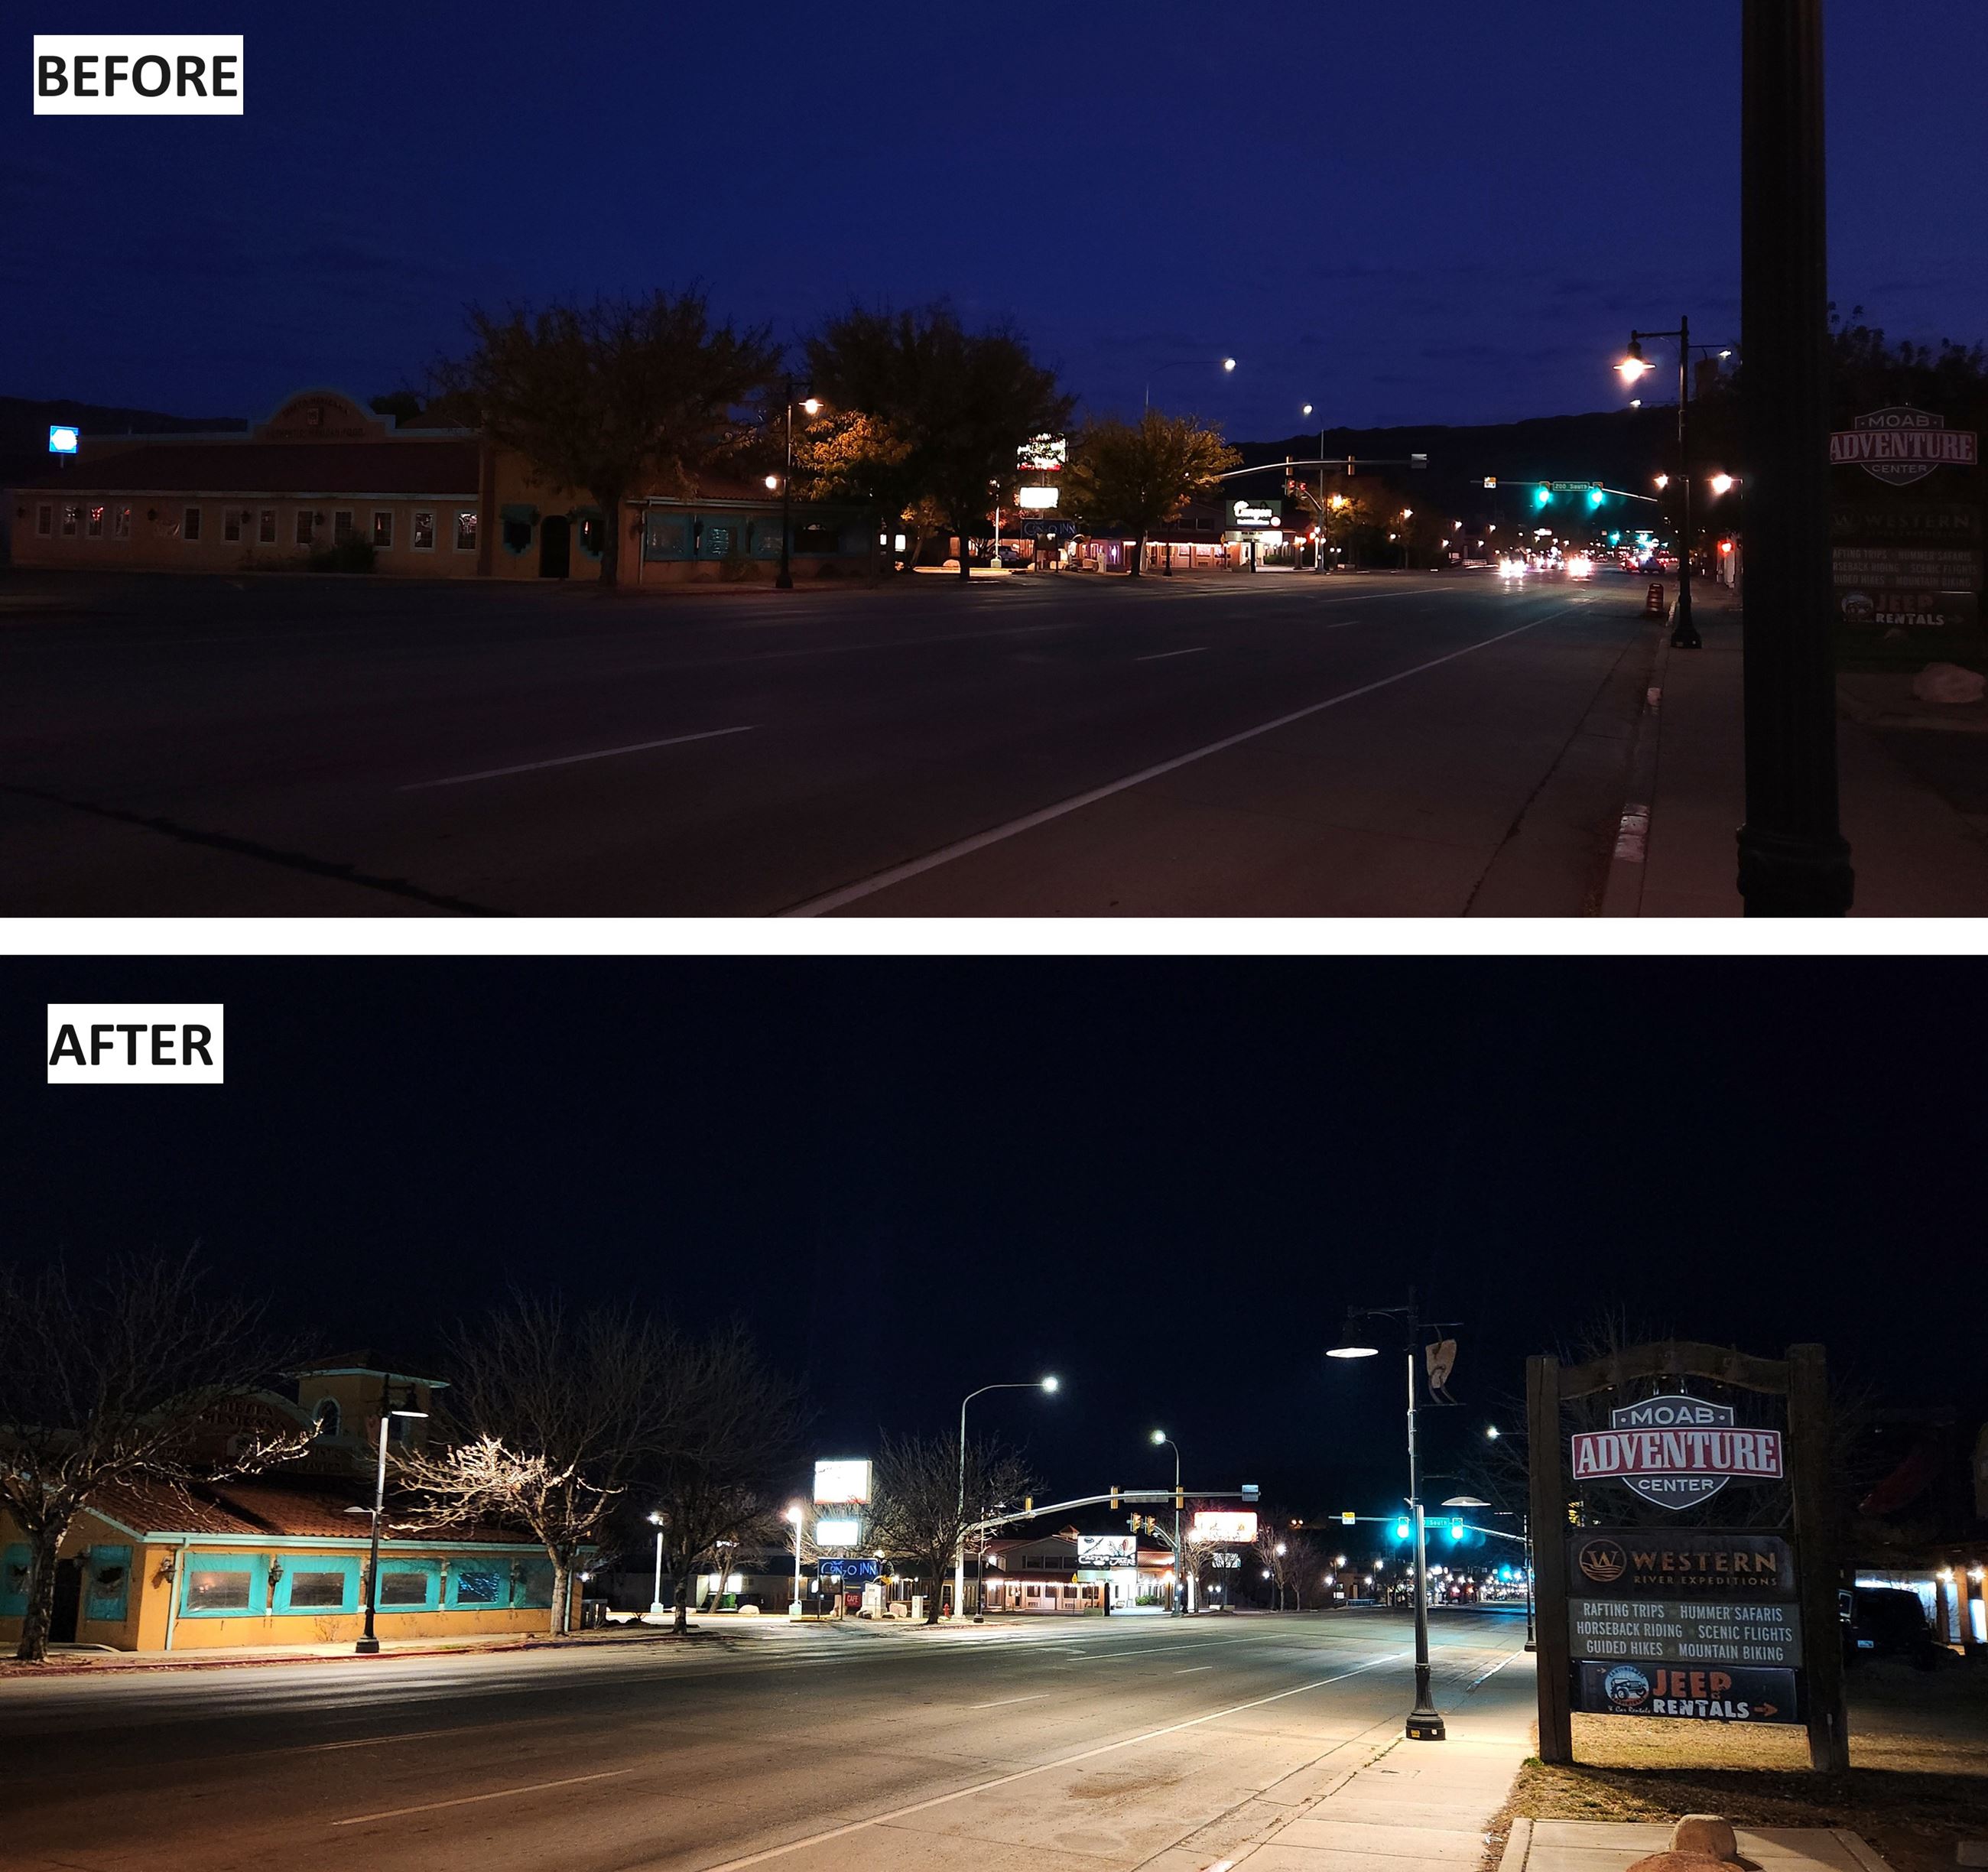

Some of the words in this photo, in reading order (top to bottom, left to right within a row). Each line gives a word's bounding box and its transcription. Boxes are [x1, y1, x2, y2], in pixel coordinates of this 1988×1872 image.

[1869, 414, 1929, 427] MOAB
[1830, 432, 1973, 461] ADVENTURE
[1872, 464, 1928, 473] CENTER
[1864, 514, 1970, 528] WESTERN
[1832, 549, 1861, 558] AFTING
[1864, 550, 1887, 559] TRIPS
[1938, 551, 1971, 561] SAFARIS
[1872, 563, 1900, 572] RIDING
[1910, 564, 1941, 574] SCENIC
[1944, 564, 1977, 574] FLIGHTS
[1861, 575, 1885, 585] HIKES
[1896, 576, 1939, 587] MOUNTAIN
[1942, 577, 1971, 587] BIKING
[1875, 594, 1934, 612] JEEP
[1875, 613, 1944, 626] RENTALS
[1631, 1406, 1714, 1425] MOAB
[1577, 1432, 1777, 1474] ADVENTURE
[1638, 1478, 1714, 1492] CENTER
[859, 1562, 877, 1575] INN
[1630, 1551, 1777, 1573] WESTERN
[1633, 1575, 1675, 1584] RIVER
[1682, 1576, 1778, 1586] EXPEDITIONS
[1584, 1602, 1629, 1617] RAFTING
[1632, 1604, 1665, 1618] TRIPS
[1680, 1605, 1730, 1620] HUMMER
[1734, 1607, 1782, 1622] SAFARIS
[1577, 1621, 1640, 1636] HORSEBACK
[1643, 1623, 1682, 1638] RIDING
[1698, 1625, 1740, 1640] SCENIC
[1744, 1627, 1792, 1642] FLIGHTS
[1587, 1640, 1626, 1654] GUIDED
[1630, 1642, 1664, 1656] HIKES
[1678, 1643, 1739, 1659] MOUNTAIN
[1743, 1646, 1784, 1661] BIKING
[1652, 1669, 1732, 1699] JEEP
[1653, 1698, 1750, 1719] RENTALS
